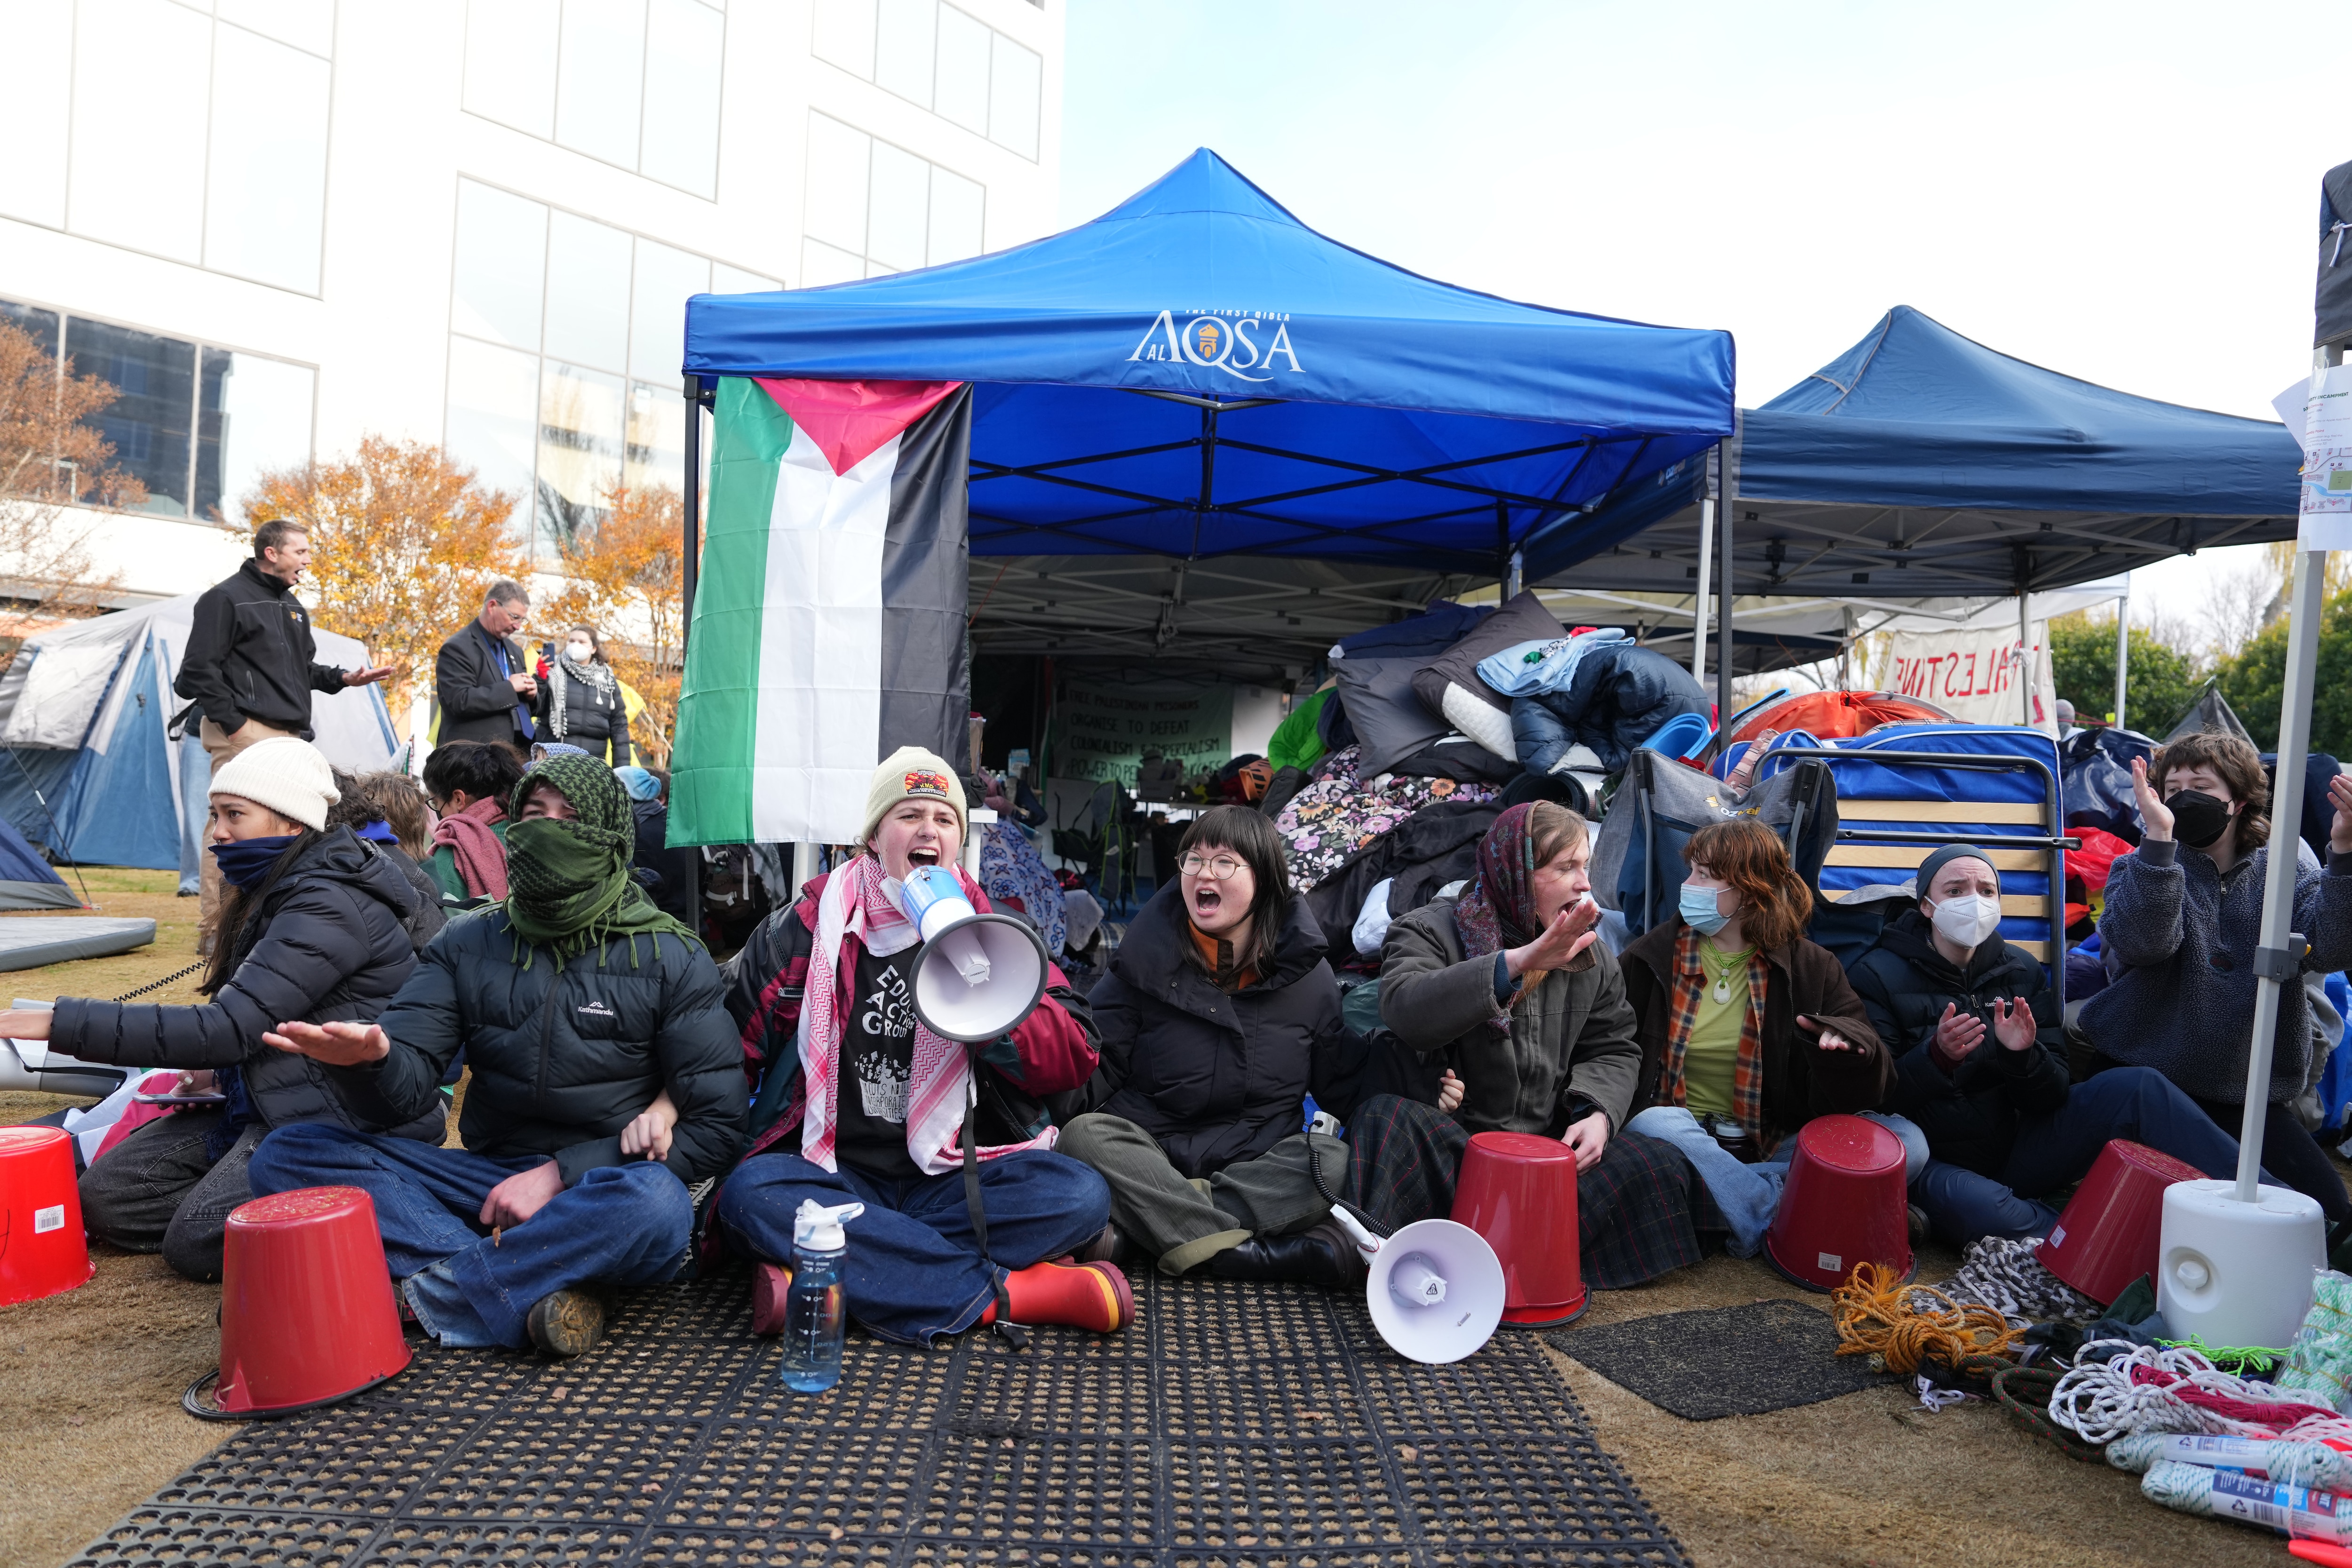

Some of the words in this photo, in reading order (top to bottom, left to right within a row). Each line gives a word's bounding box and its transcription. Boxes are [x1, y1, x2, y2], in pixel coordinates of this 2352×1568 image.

[1255, 311, 1290, 322] QIBLA
[1125, 310, 1306, 382] AQSA
[1095, 694, 1149, 711] PALESTINIAN
[1070, 713, 1119, 732] ORGANISE
[1128, 719, 1143, 734] TO
[1150, 719, 1190, 735] DEFEAT
[1071, 735, 1133, 755] COLONIALISM
[578, 1006, 613, 1016] Kathmandu
[865, 990, 914, 1030] ACTION
[862, 1011, 907, 1038] GROUP
[868, 1083, 887, 1095] CUTS
